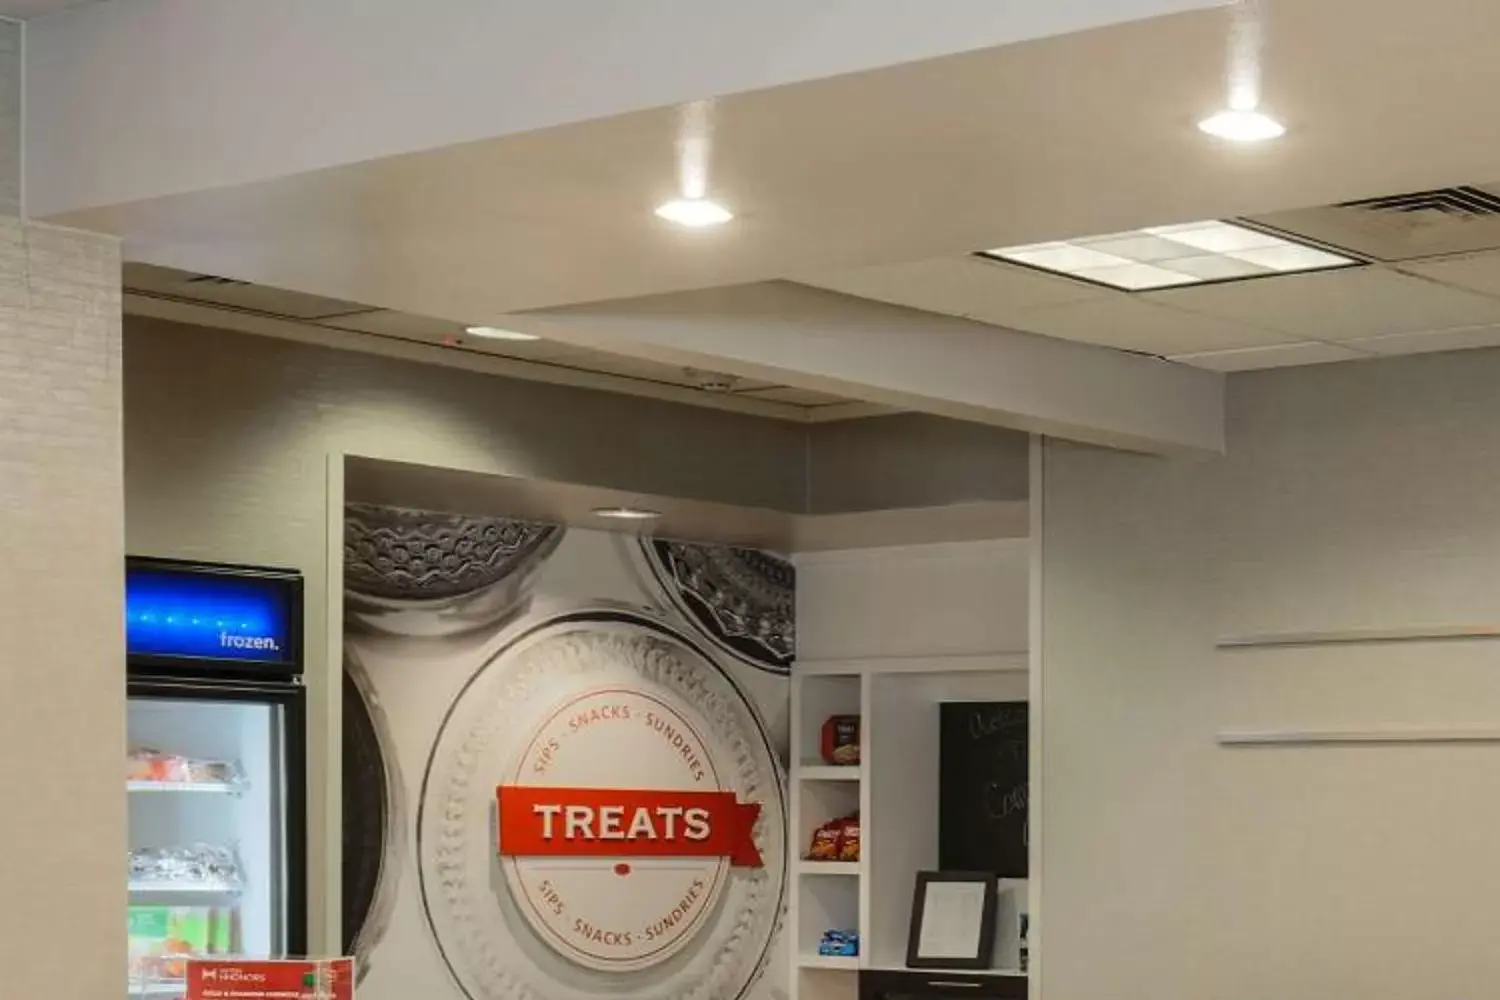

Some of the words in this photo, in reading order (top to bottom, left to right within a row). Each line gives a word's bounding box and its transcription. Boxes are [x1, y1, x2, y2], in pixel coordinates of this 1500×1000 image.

[220, 632, 279, 651] frozen.
[533, 736, 560, 775] SIPS
[568, 705, 630, 731] SNACKS
[645, 713, 704, 782] SUNDRIES
[532, 804, 711, 840] TREATS
[539, 880, 565, 916] SIPS
[573, 918, 632, 946] SNACKS
[645, 879, 704, 941] SUNDRIES
